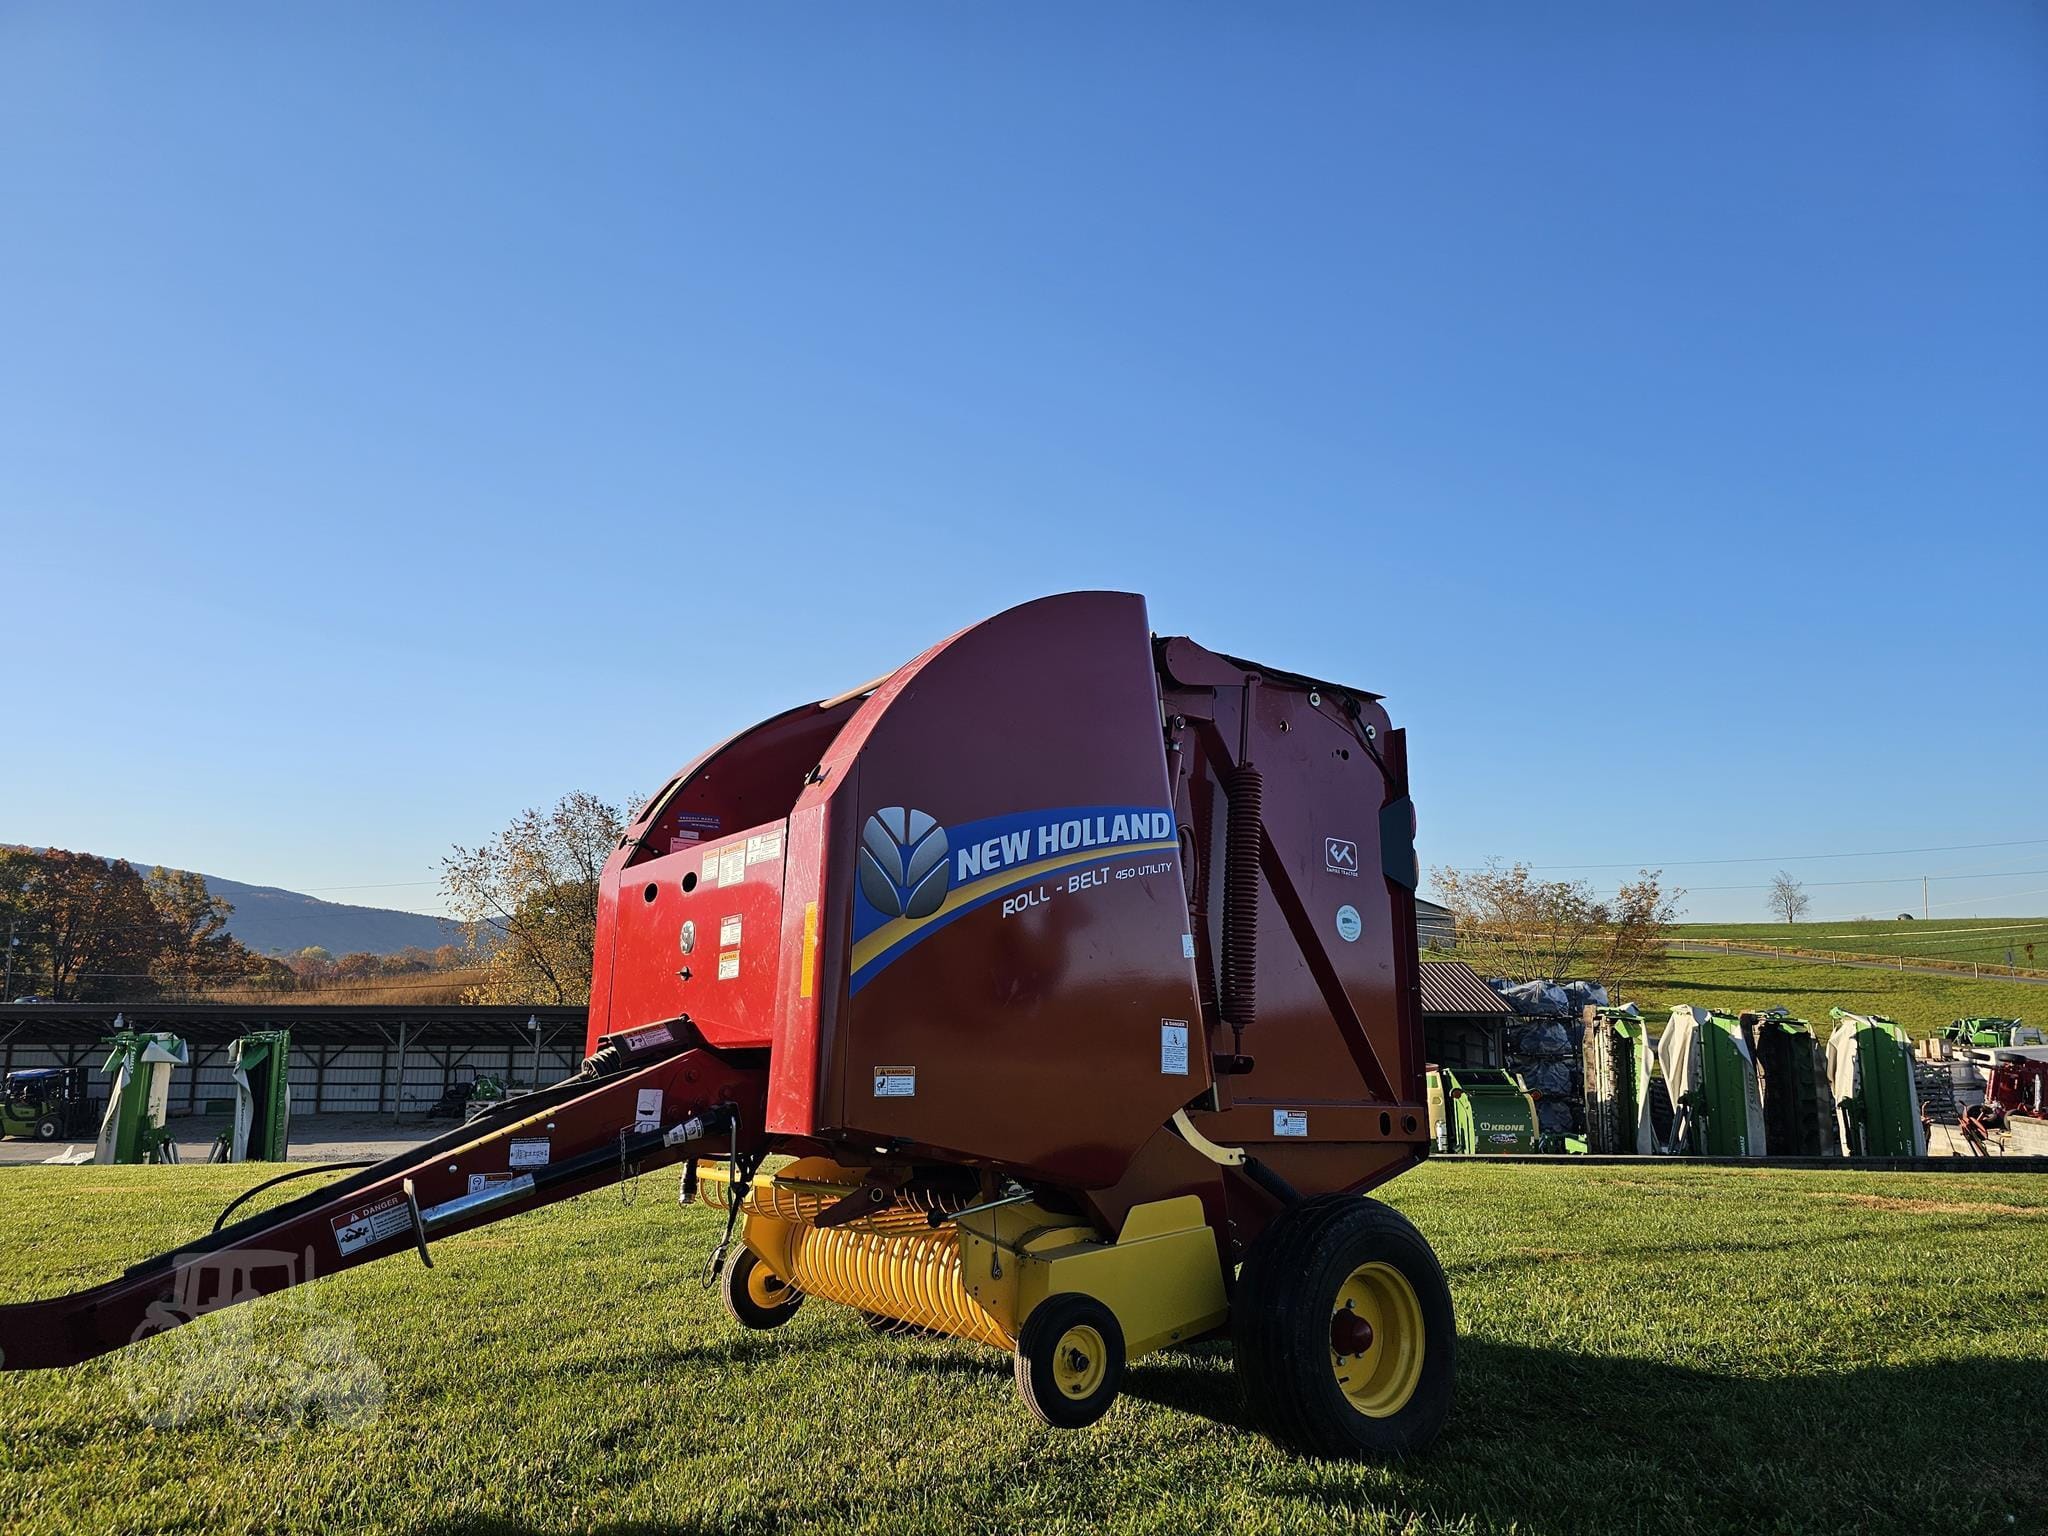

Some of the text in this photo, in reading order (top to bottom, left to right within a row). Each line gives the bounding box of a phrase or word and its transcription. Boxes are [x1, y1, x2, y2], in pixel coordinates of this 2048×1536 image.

[957, 812, 1171, 881] NEW HOLLAND
[1002, 886, 1051, 919] ROLL
[1068, 867, 1110, 894] BELT
[1115, 867, 1136, 881] 450
[1137, 861, 1173, 877] UTILITY
[362, 1197, 399, 1216] DANGER
